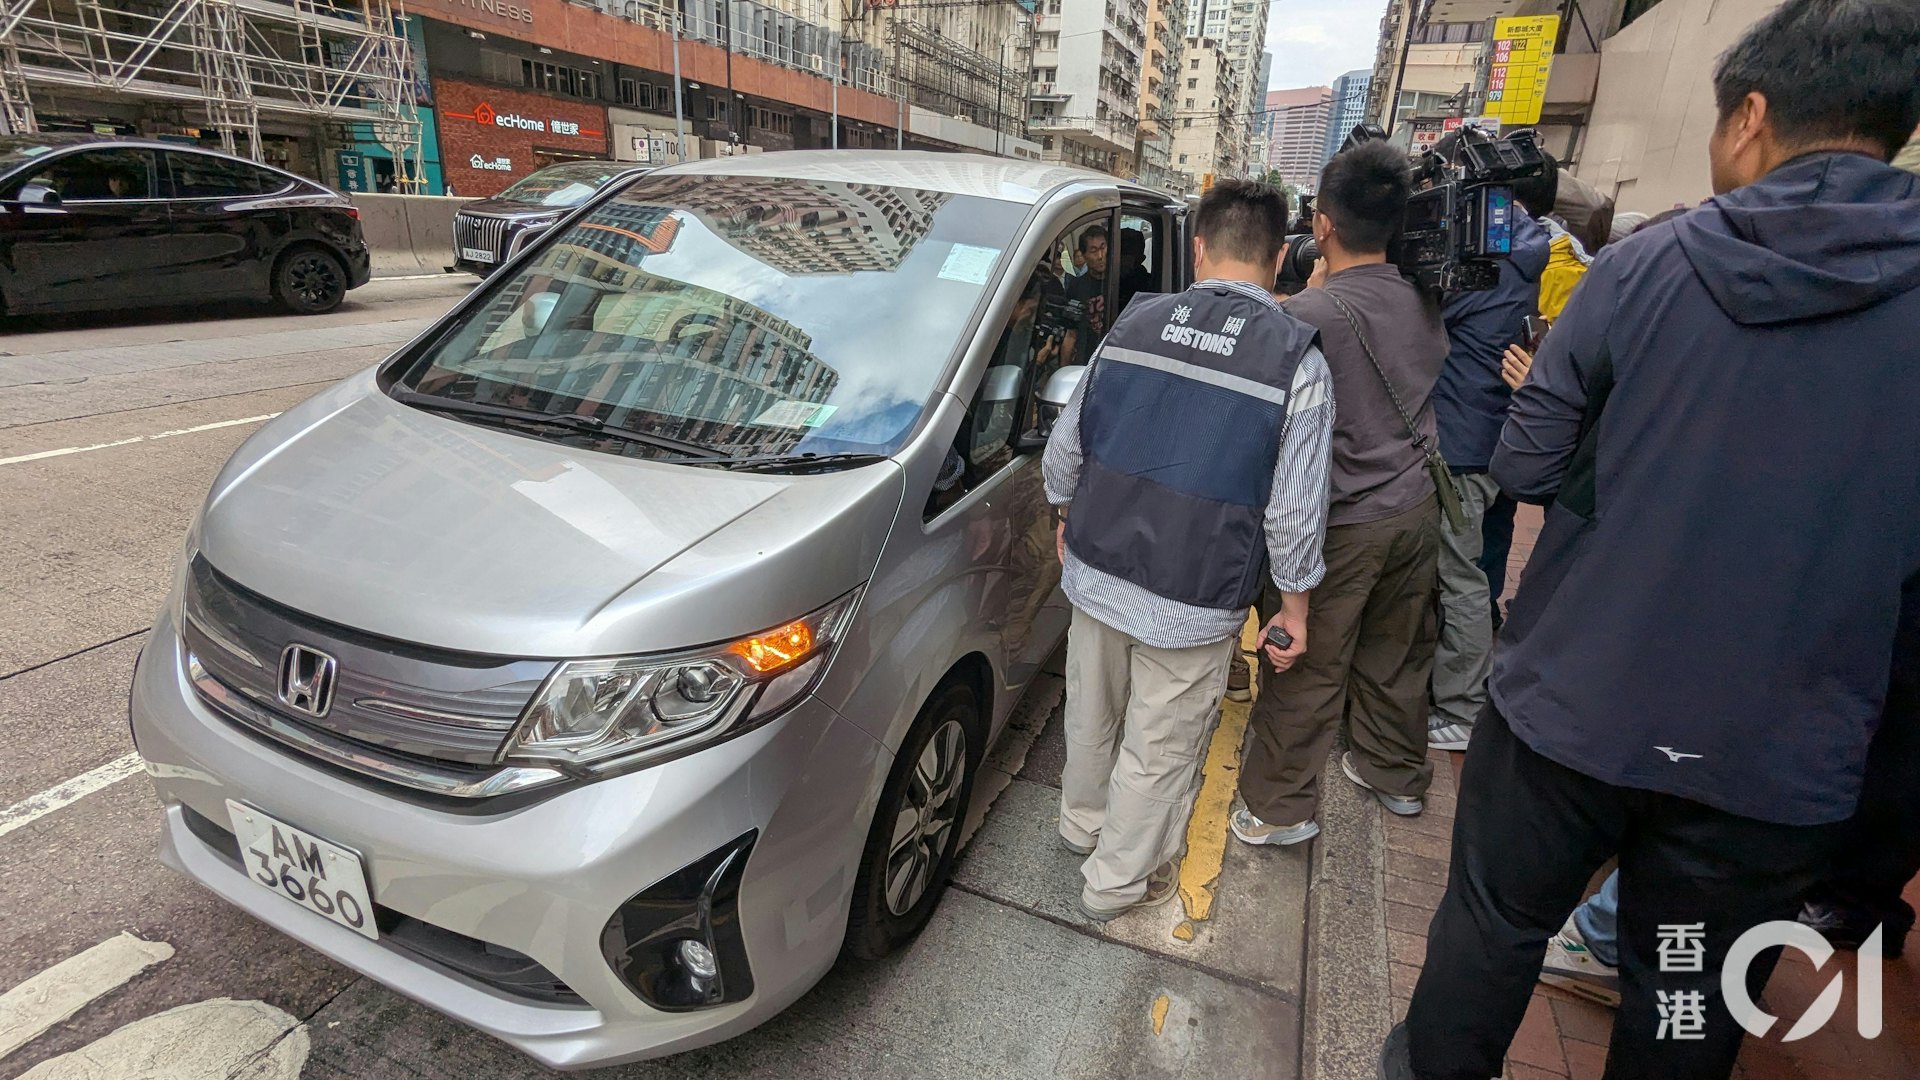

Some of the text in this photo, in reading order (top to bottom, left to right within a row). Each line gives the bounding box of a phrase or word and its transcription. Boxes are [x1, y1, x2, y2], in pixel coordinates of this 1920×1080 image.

[448, 0, 533, 23] NESS
[1497, 40, 1511, 51] 102
[1495, 52, 1509, 63] 106
[1493, 67, 1506, 78] 112
[1491, 79, 1504, 89] 116
[1488, 90, 1502, 100] 979
[496, 114, 544, 131] ecHome
[551, 119, 579, 135] 億世家
[484, 162, 512, 171] ecHome
[465, 250, 491, 260] AJ 2822
[1161, 323, 1237, 356] CUSTOMS
[272, 824, 327, 881] AM
[249, 846, 364, 929] 3660
